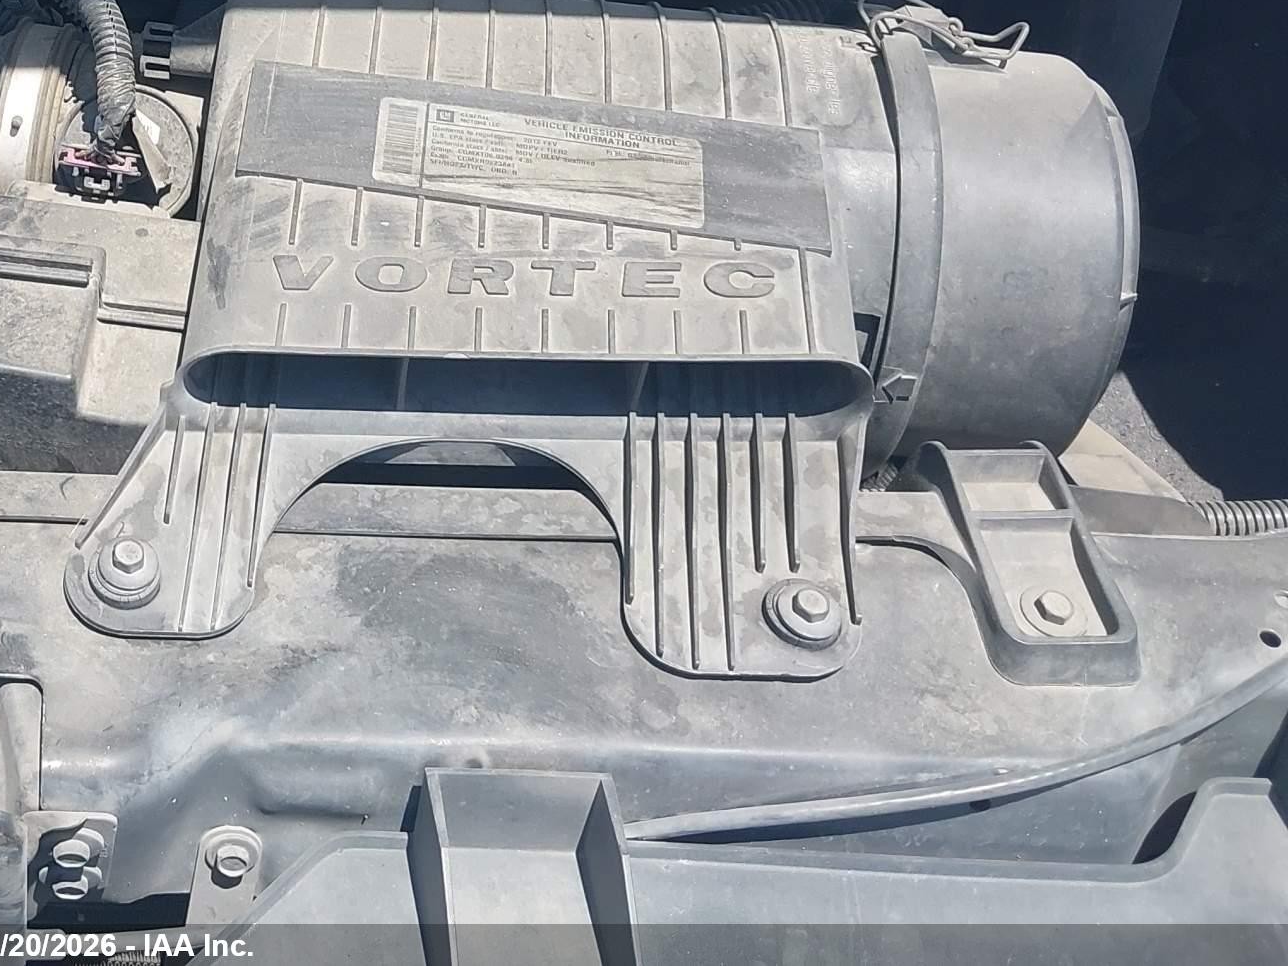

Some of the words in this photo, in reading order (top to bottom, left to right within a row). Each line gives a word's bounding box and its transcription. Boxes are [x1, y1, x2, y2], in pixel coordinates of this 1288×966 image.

[524, 118, 569, 132] VEHICLE
[572, 125, 624, 140] EMISSION
[628, 133, 678, 147] CONTROL
[565, 131, 640, 150] INFORMATION
[271, 256, 776, 298] VORTEC
